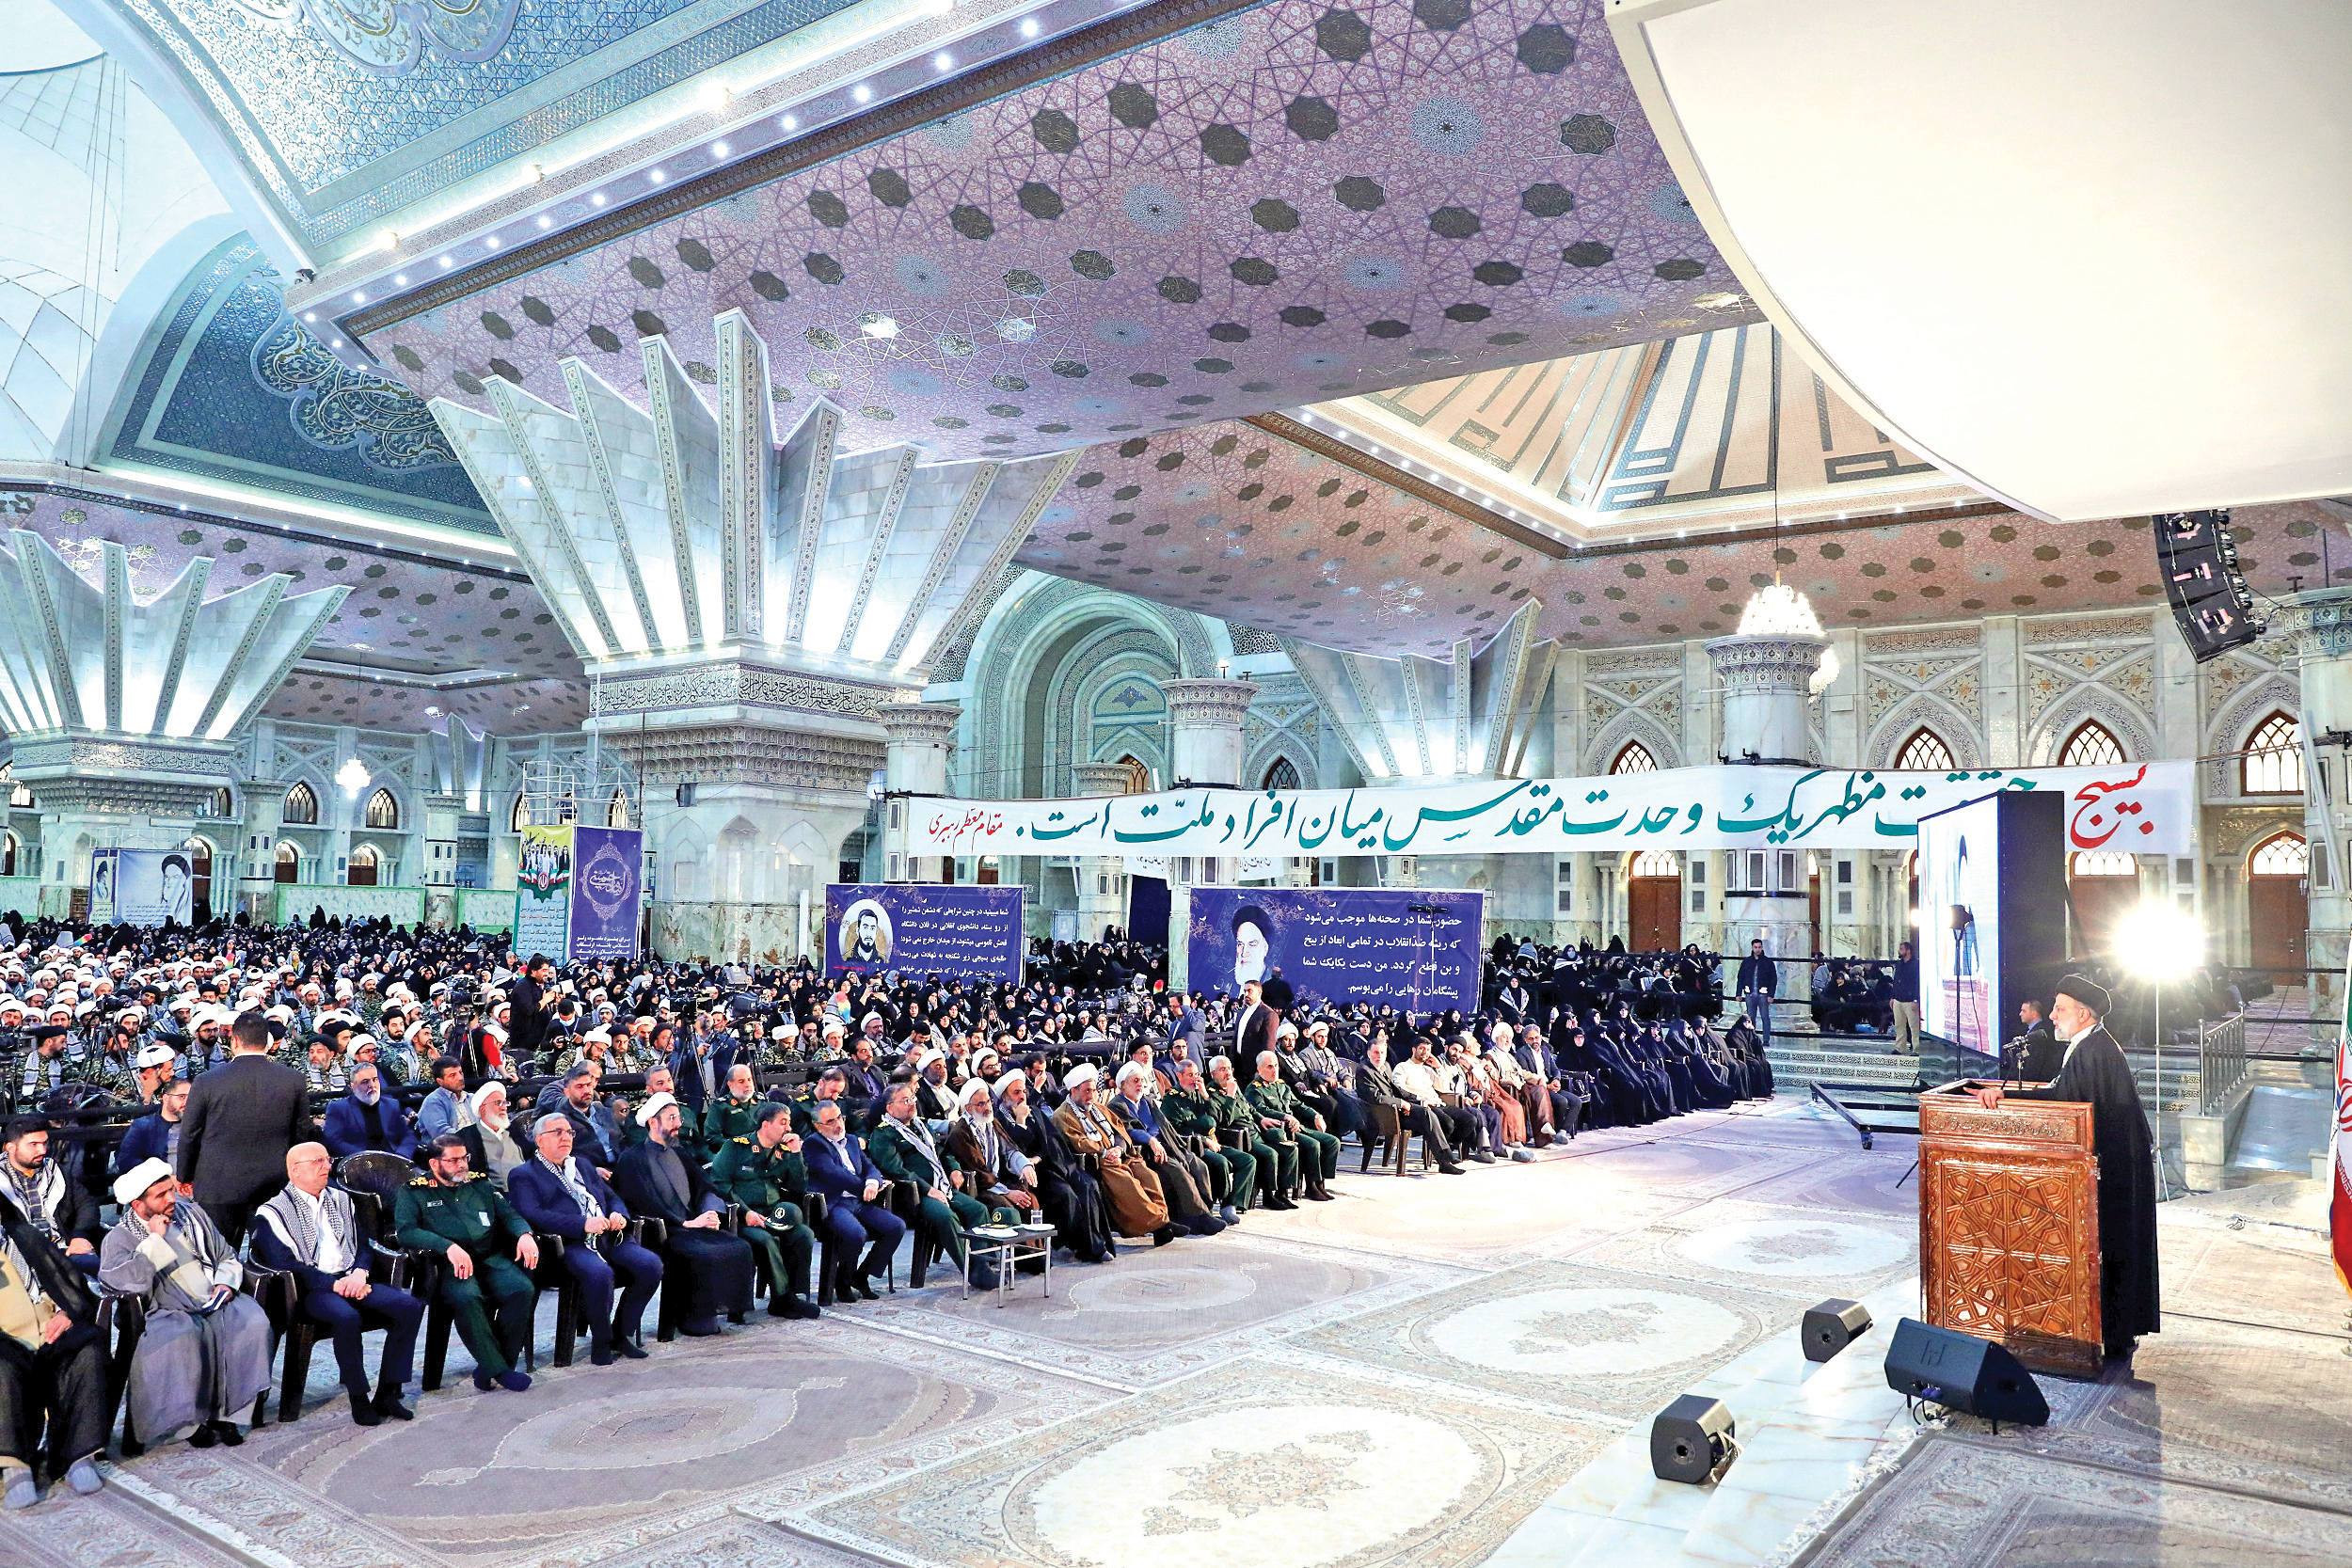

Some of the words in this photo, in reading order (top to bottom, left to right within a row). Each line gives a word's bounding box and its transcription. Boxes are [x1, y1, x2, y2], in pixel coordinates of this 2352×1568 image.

[1717, 769, 1831, 844] یک
[1793, 770, 1886, 840] مظهر
[2071, 763, 2153, 848] بسیج
[1298, 788, 1384, 848] میان
[1384, 780, 1565, 852] مقدس
[1563, 789, 1704, 837] وحدت
[1219, 790, 1298, 849] افراد
[929, 814, 961, 844] رهبری
[971, 813, 1003, 853] مقام
[1337, 914, 1365, 926] موجب
[1404, 914, 1414, 926] در
[1418, 914, 1432, 925] شما
[1436, 915, 1461, 928] حضور
[1304, 934, 1317, 947] بیخ
[1319, 935, 1327, 945] از
[1328, 936, 1345, 944] ابعاد
[1347, 937, 1372, 948] تمامی
[1374, 938, 1384, 948] در
[1450, 940, 1461, 948] که
[1302, 957, 1317, 967] شما
[1319, 958, 1346, 970] یکایک
[1349, 960, 1372, 969] دست
[1375, 960, 1388, 972] من
[1440, 965, 1452, 975] بن
[1454, 965, 1460, 974] و
[1385, 983, 1393, 994] را
[1394, 985, 1421, 996] رهایی
